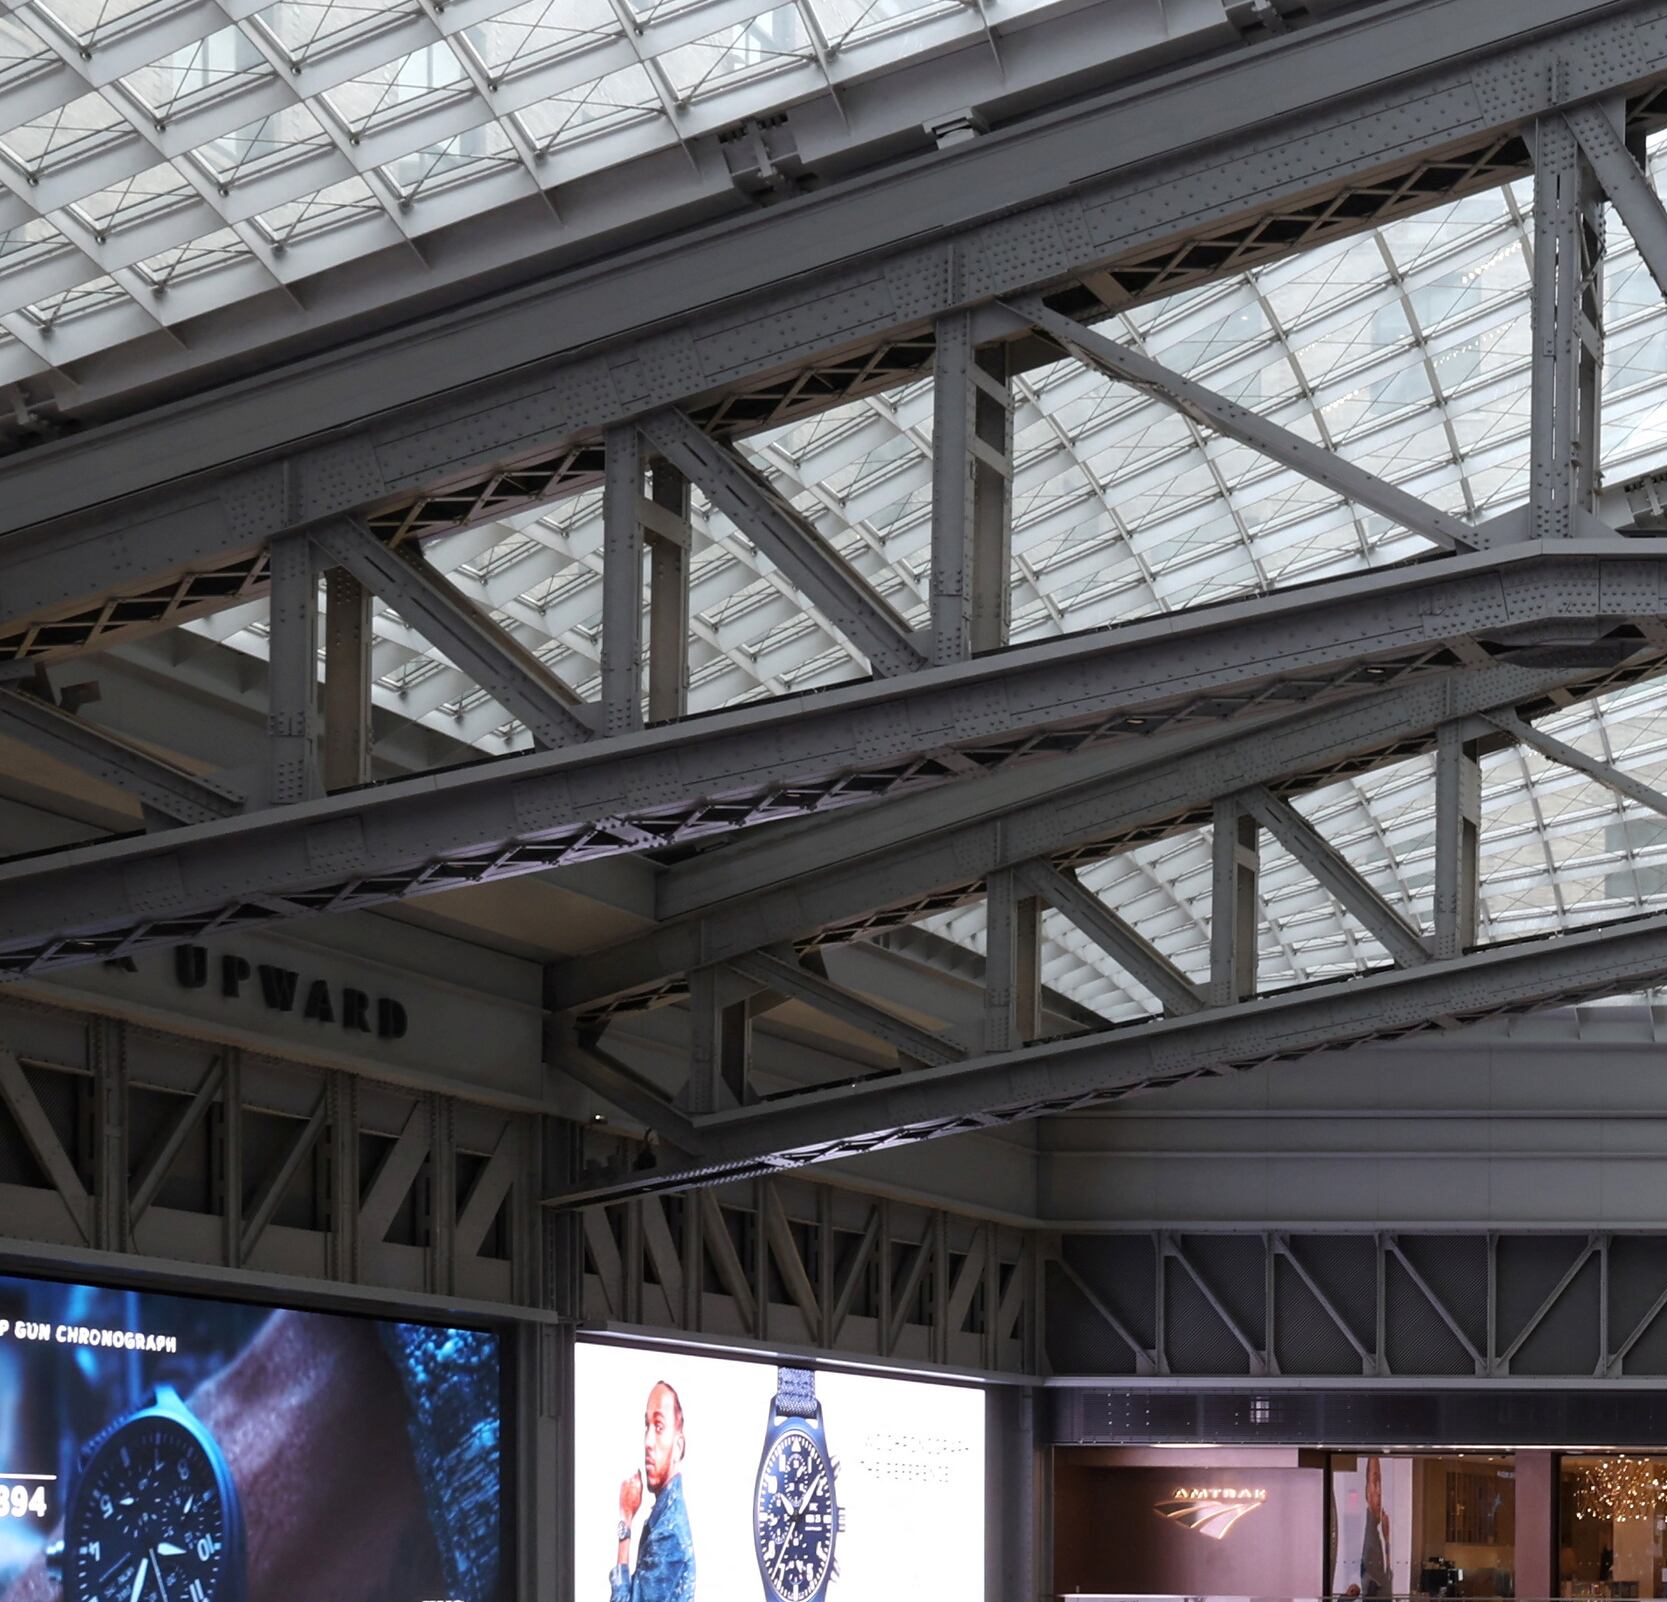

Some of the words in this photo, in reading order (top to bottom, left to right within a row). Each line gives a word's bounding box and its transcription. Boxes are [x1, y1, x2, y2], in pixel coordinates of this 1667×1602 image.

[173, 944, 407, 1038] UPWARD
[14, 1320, 51, 1341] GUN
[55, 1325, 177, 1353] CHRONOGRAPH
[1174, 1487, 1268, 1500] AMTRAK
